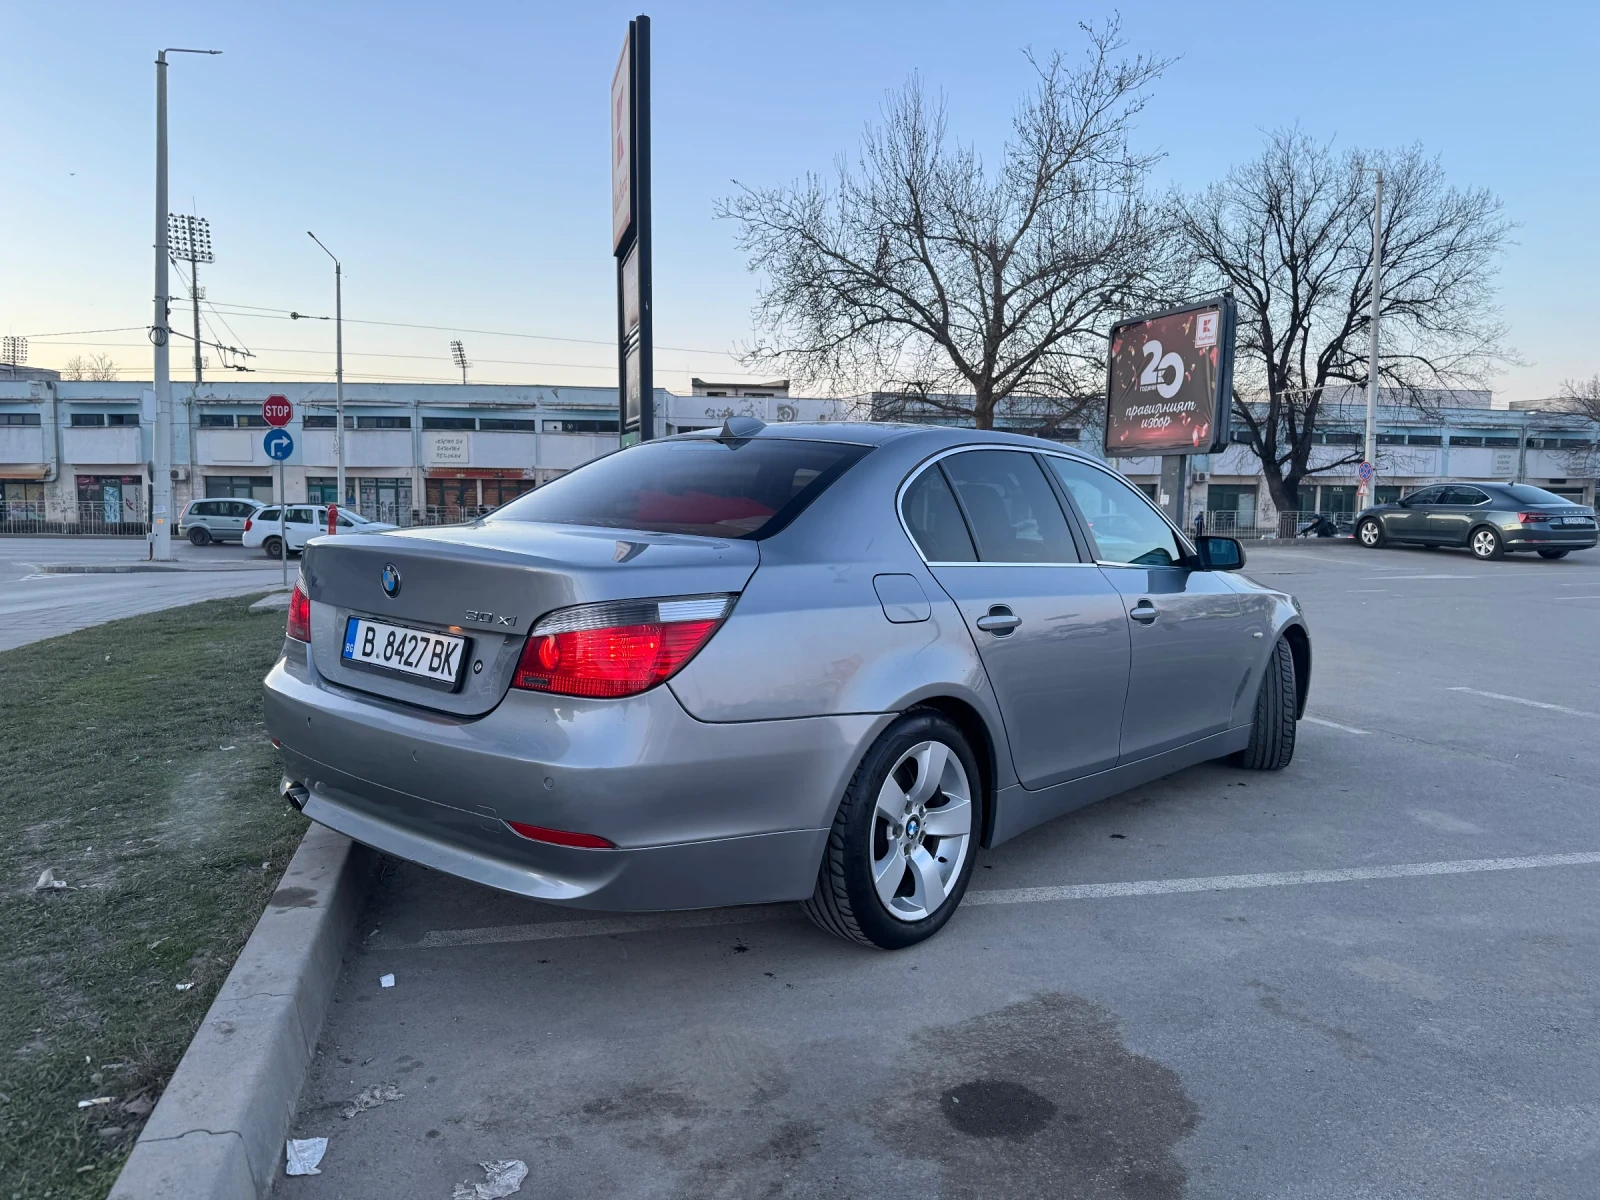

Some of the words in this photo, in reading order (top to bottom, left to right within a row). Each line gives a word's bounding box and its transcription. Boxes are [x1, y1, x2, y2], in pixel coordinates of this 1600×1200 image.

[1140, 340, 1185, 399] 20
[265, 405, 290, 417] STOP
[1141, 413, 1173, 432] избор
